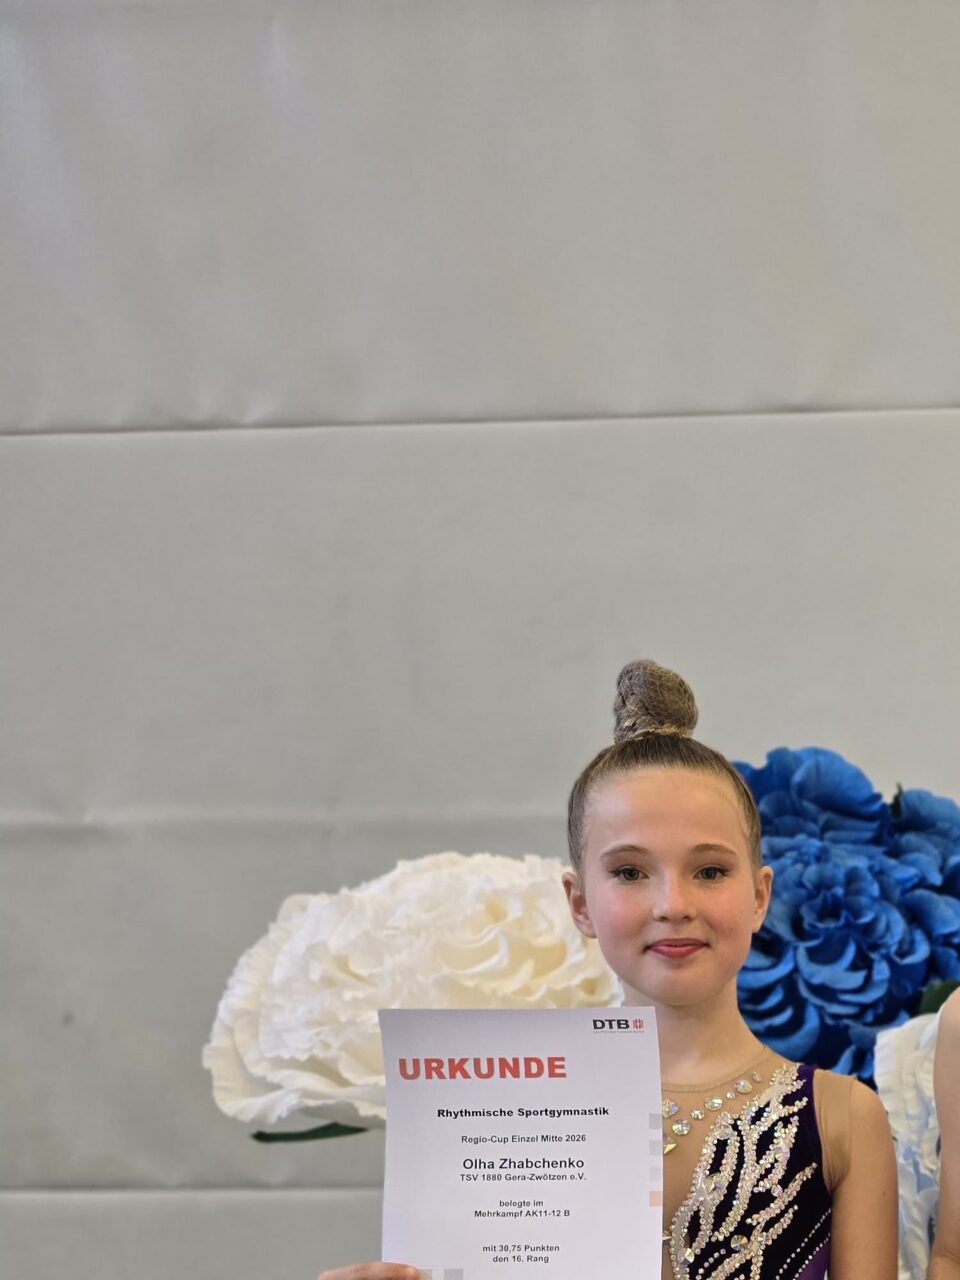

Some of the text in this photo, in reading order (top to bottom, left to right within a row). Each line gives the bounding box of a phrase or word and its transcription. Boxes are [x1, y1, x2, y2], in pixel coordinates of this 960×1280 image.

[593, 1019, 629, 1030] DTB
[399, 1057, 567, 1080] URKUNDE
[437, 1107, 610, 1119] Rhythmische Sportgymnastik
[461, 1134, 586, 1144] Regio-Cup Einzel Mitte 2026
[463, 1158, 585, 1169] Olha Zhabchenko
[460, 1173, 478, 1181] TSV
[481, 1173, 502, 1181] 1880
[504, 1173, 567, 1181] Gera-Zwötzen
[499, 1200, 531, 1208] belegte
[474, 1210, 523, 1219] Mehrkampf
[524, 1244, 560, 1252] Punkten
[492, 1255, 509, 1263] den
[526, 1255, 550, 1263] Rang
